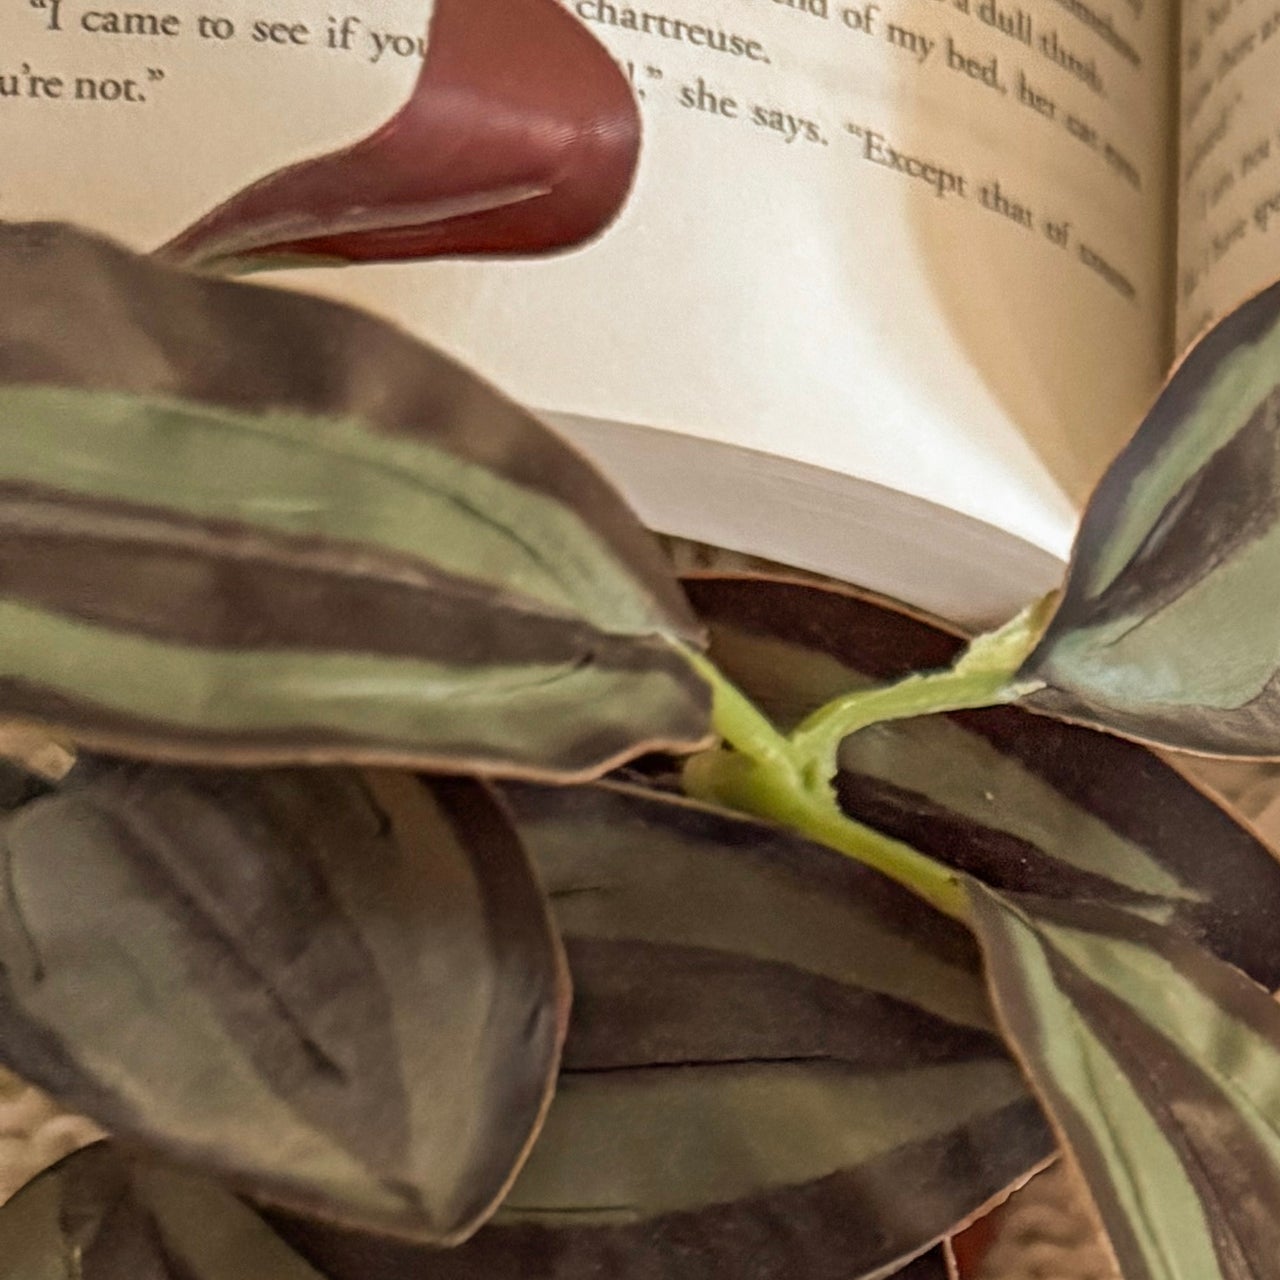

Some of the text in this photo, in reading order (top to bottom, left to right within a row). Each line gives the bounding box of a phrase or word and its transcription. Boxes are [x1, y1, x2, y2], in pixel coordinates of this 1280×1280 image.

[574, 0, 772, 65] chartreuse.
[842, 4, 881, 35] of
[886, 23, 935, 63] my
[75, 66, 165, 102] not.”
[80, 7, 181, 36] came
[199, 14, 235, 40] to
[251, 21, 309, 45] see
[326, 16, 361, 50] if
[678, 76, 738, 118] she
[751, 101, 829, 146] says.
[846, 121, 968, 198] “Except
[976, 180, 1034, 229] that
